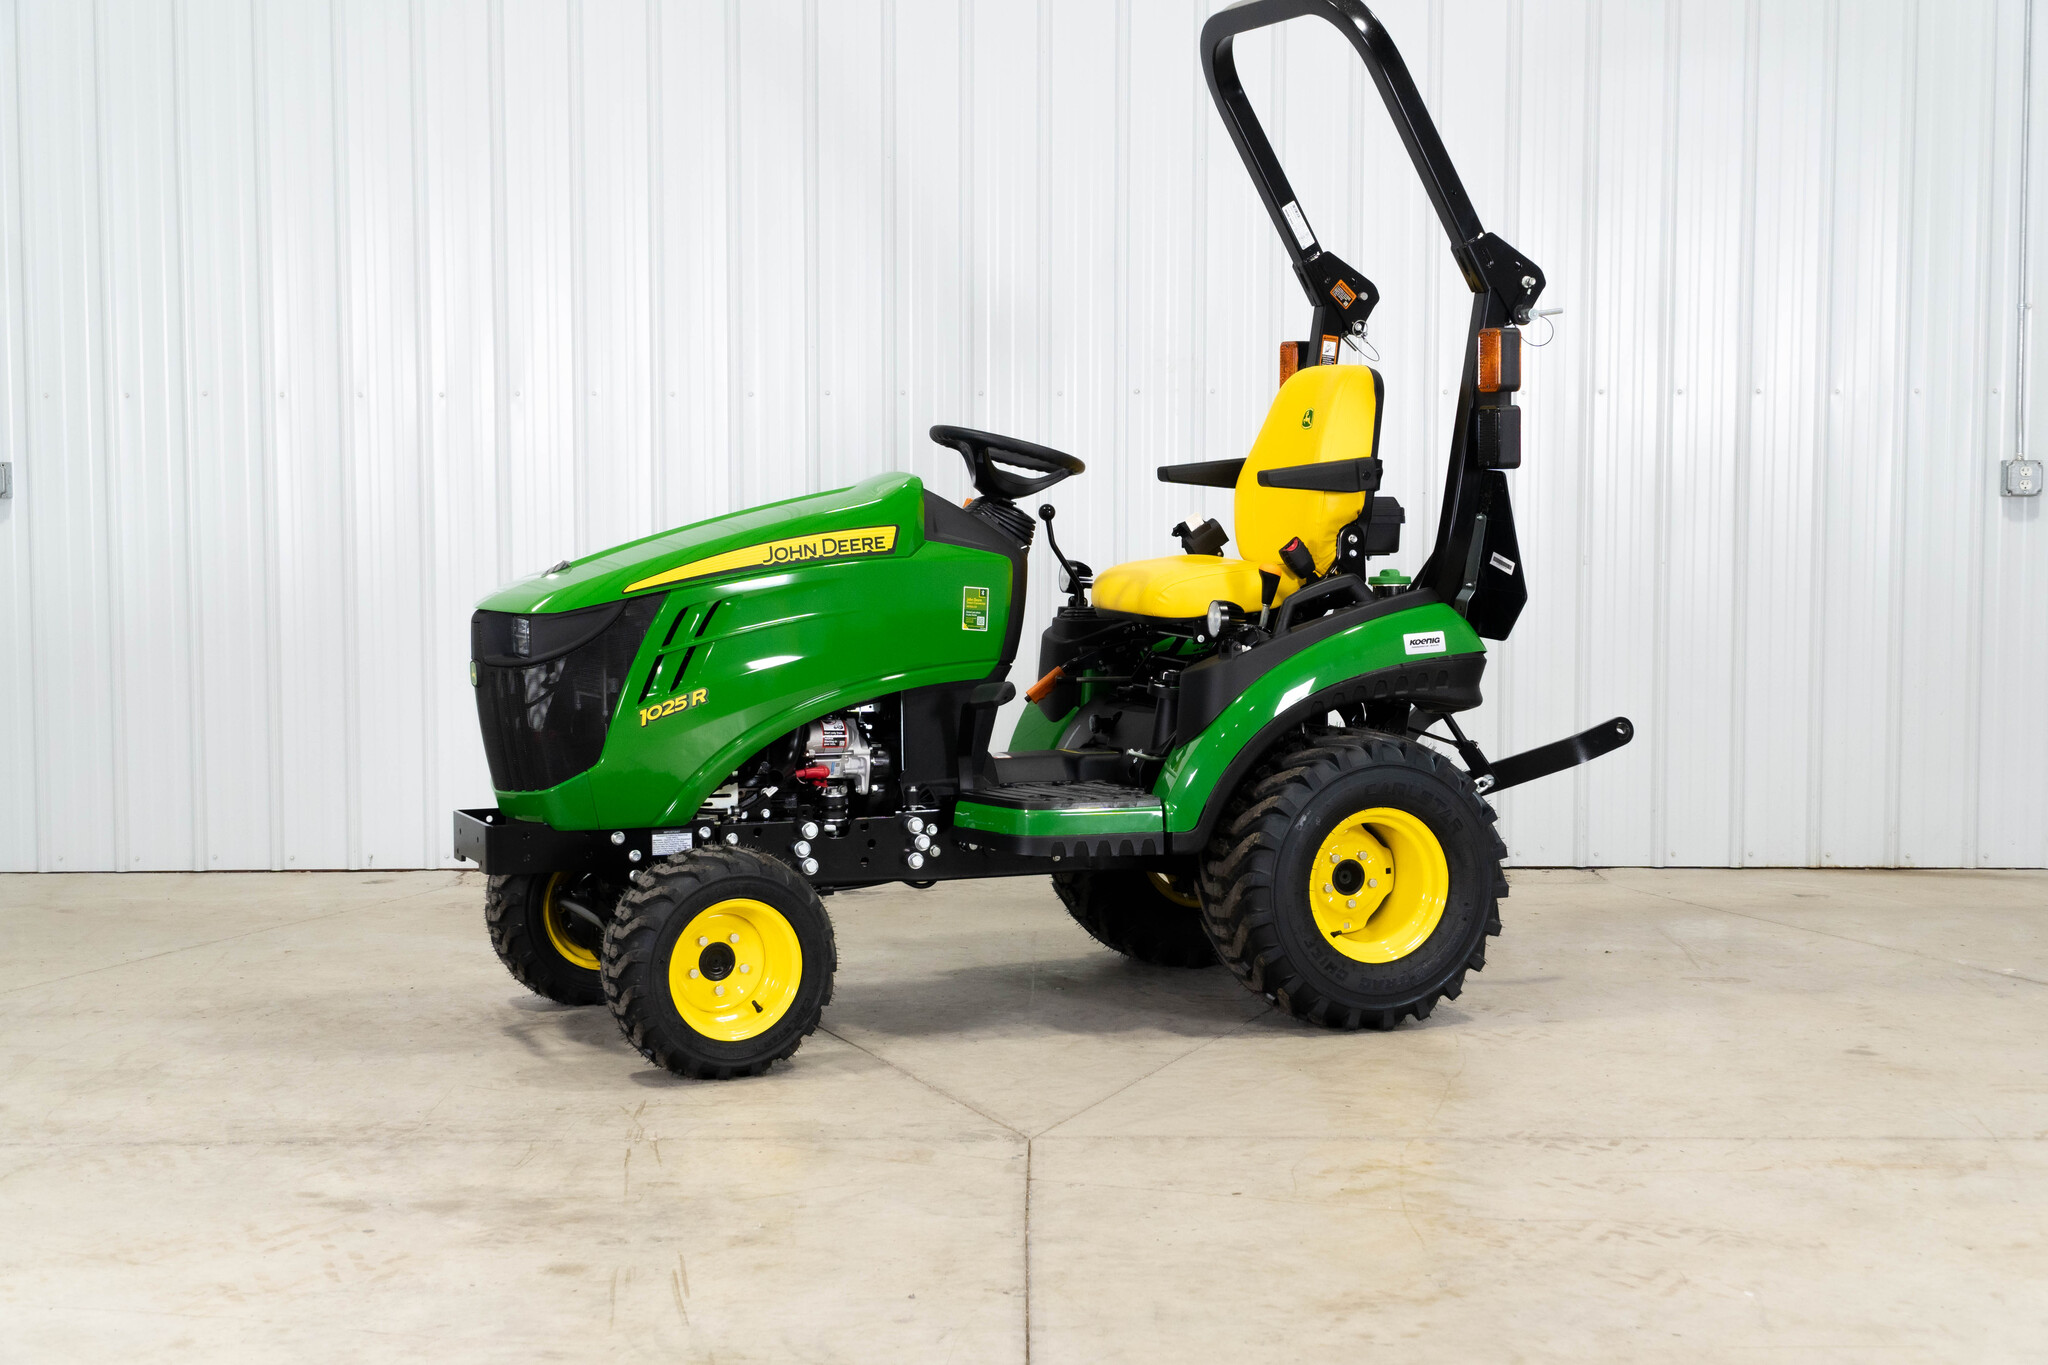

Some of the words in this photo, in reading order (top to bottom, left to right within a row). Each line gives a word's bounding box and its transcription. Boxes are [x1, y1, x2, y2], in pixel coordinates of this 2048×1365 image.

[763, 542, 817, 563] JOHN
[822, 536, 886, 555] DEERE
[640, 694, 689, 728] 1025
[692, 688, 709, 708] R
